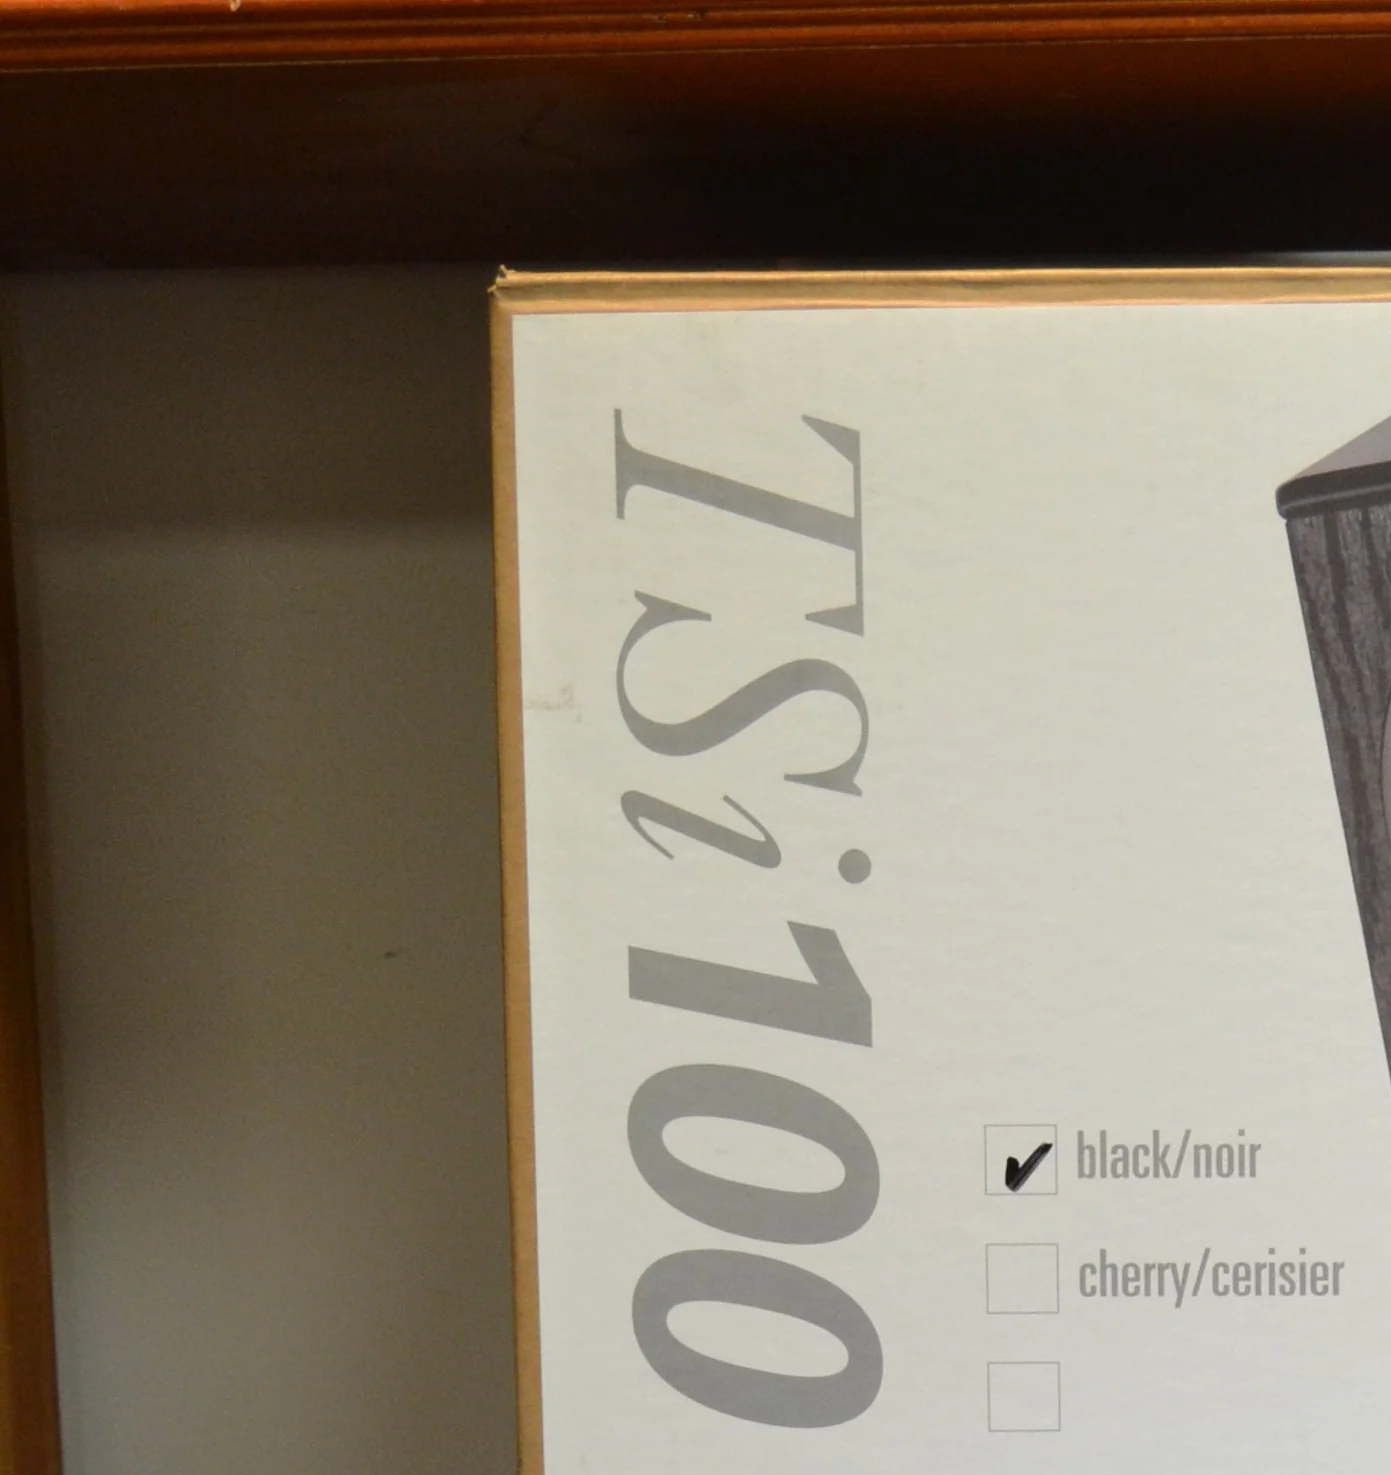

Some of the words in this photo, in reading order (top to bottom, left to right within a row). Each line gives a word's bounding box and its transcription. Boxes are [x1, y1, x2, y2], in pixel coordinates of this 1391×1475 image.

[612, 406, 885, 1430] TSi100
[1076, 1128, 1262, 1180] black/noir
[1078, 1247, 1346, 1309] cherry/cerisier
